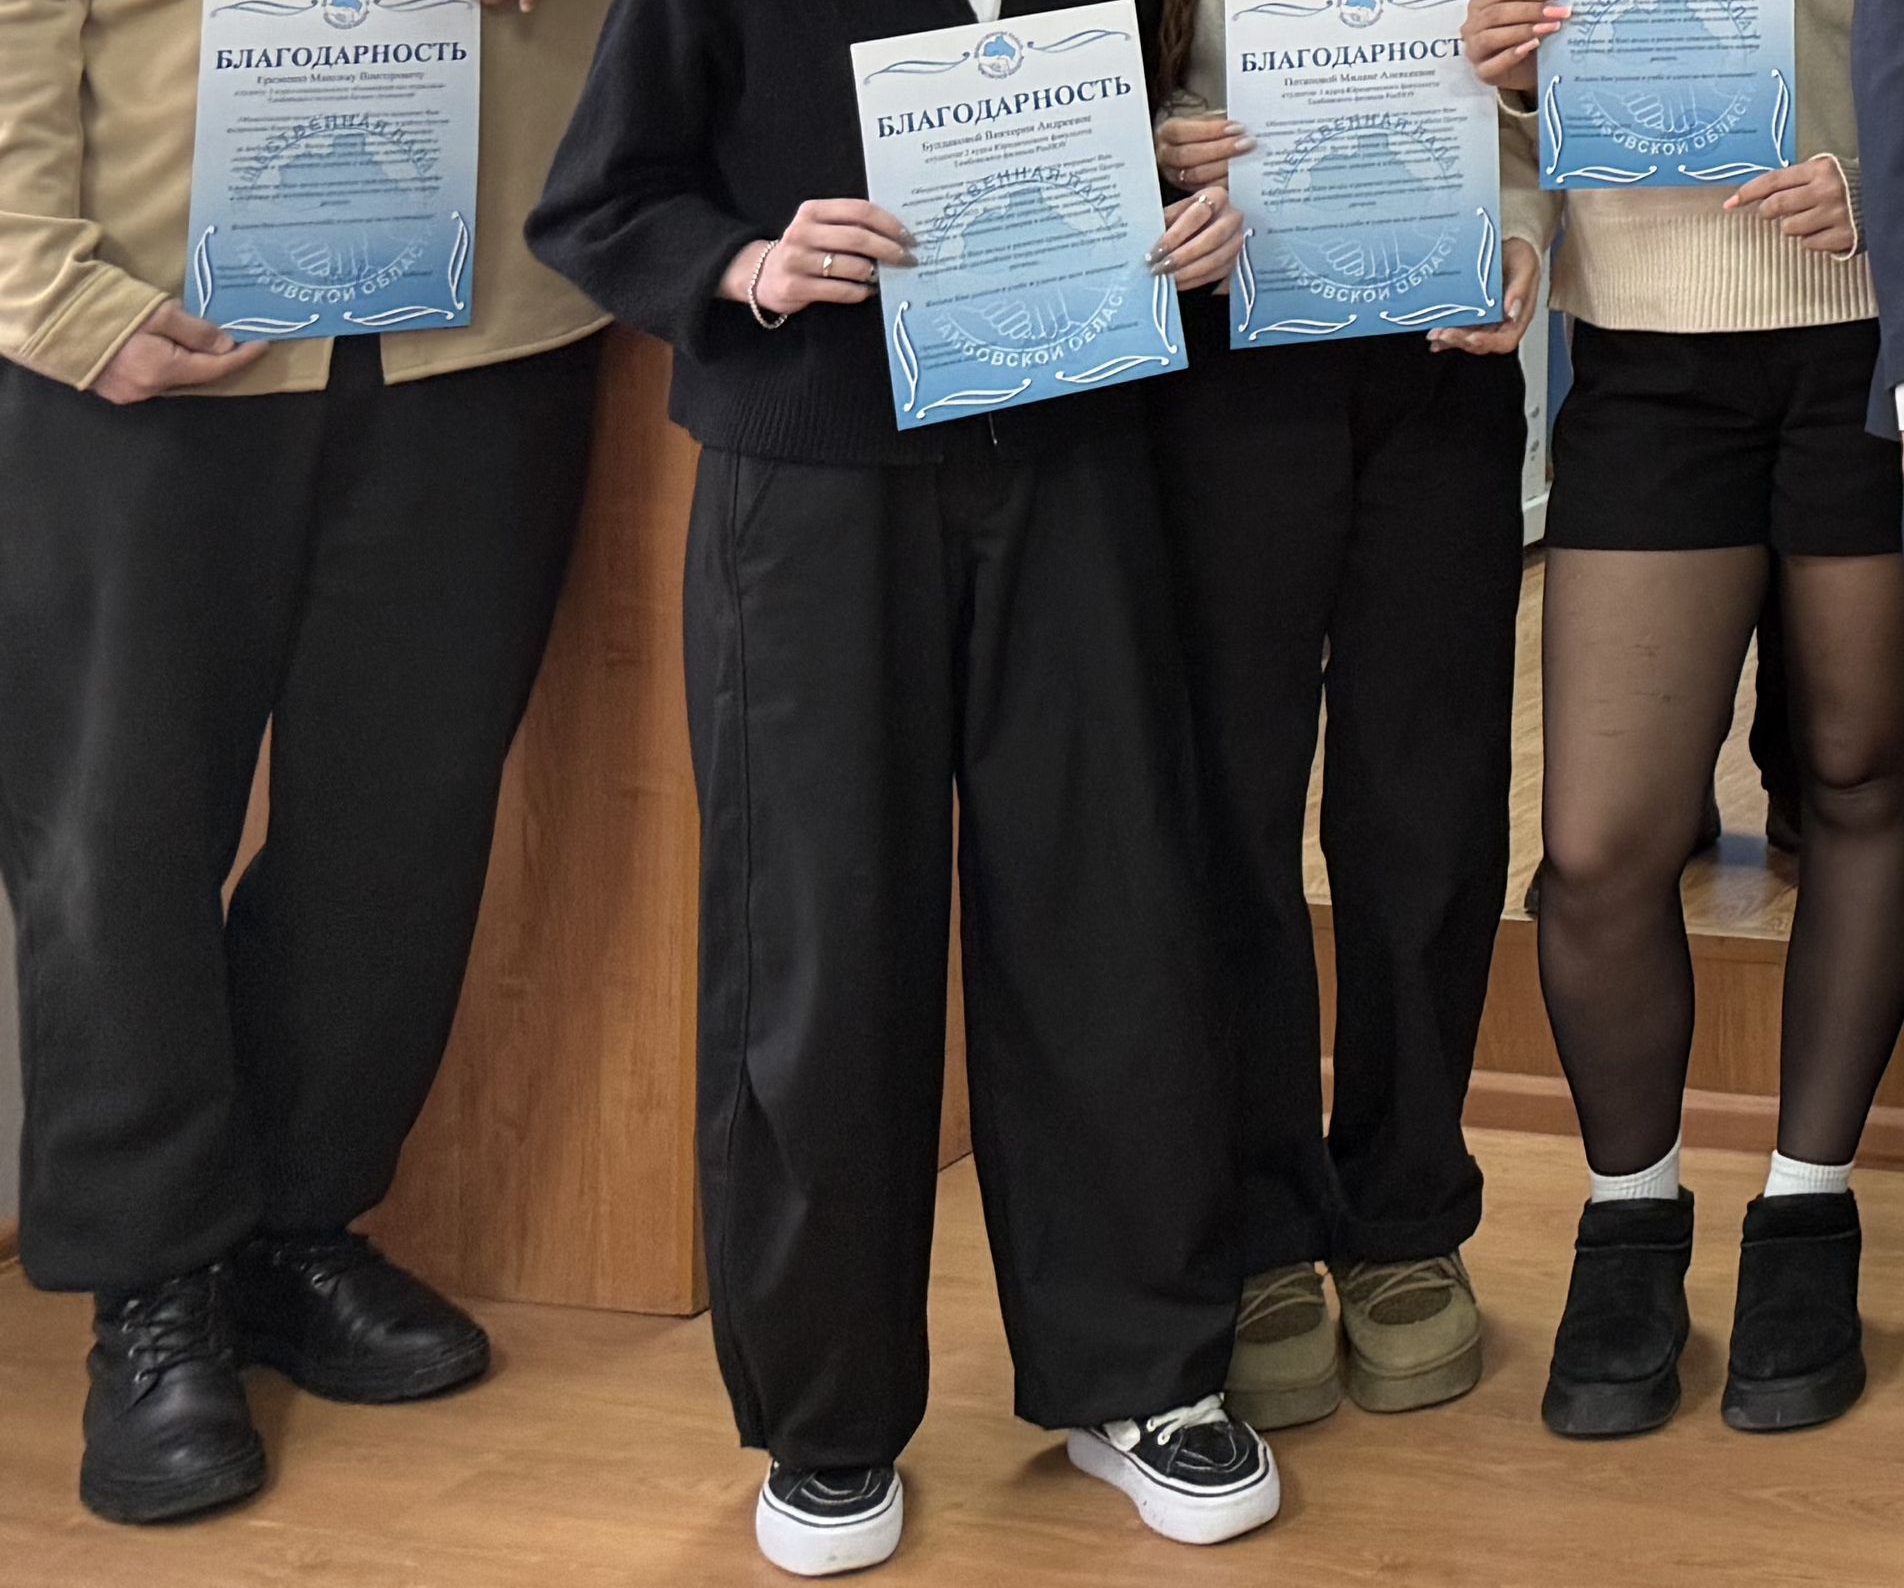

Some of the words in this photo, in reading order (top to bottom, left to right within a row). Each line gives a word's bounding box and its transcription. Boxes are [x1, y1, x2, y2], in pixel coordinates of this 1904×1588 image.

[216, 41, 468, 70] БЛАГОДАРНОСТЬ
[1241, 37, 1464, 73] БЛАГОДАРНОСТ
[876, 75, 1132, 138] БЛАГОДАРНОСТЬ
